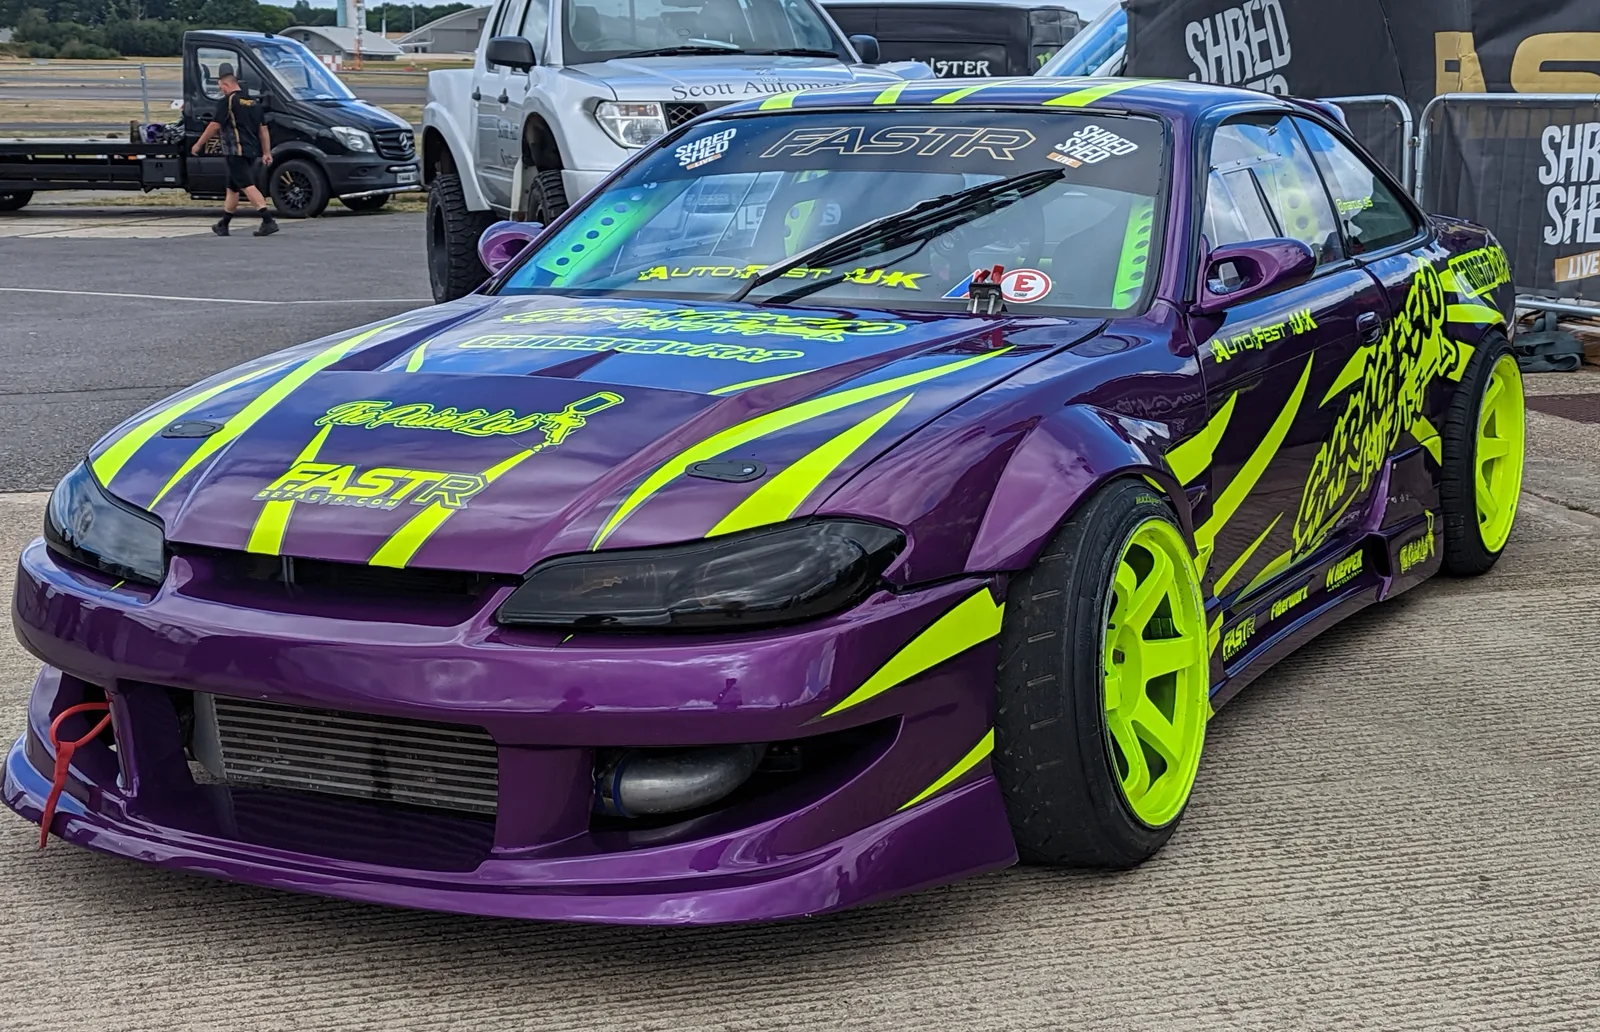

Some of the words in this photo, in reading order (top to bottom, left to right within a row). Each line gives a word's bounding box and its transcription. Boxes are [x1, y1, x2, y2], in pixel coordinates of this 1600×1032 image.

[1185, 0, 1291, 86] SHRED
[671, 83, 735, 101] Scott
[674, 128, 737, 158] SHRED
[679, 140, 729, 166] SHED
[759, 126, 1037, 160] FASTR
[1054, 137, 1111, 164] SHED
[1073, 124, 1139, 155] SHRED
[1013, 274, 1037, 292] E
[314, 401, 391, 427] The
[366, 403, 489, 430] Paint
[453, 408, 543, 437] Lab
[257, 490, 401, 508] BEFASTR.COM
[265, 461, 485, 507] FASTR
